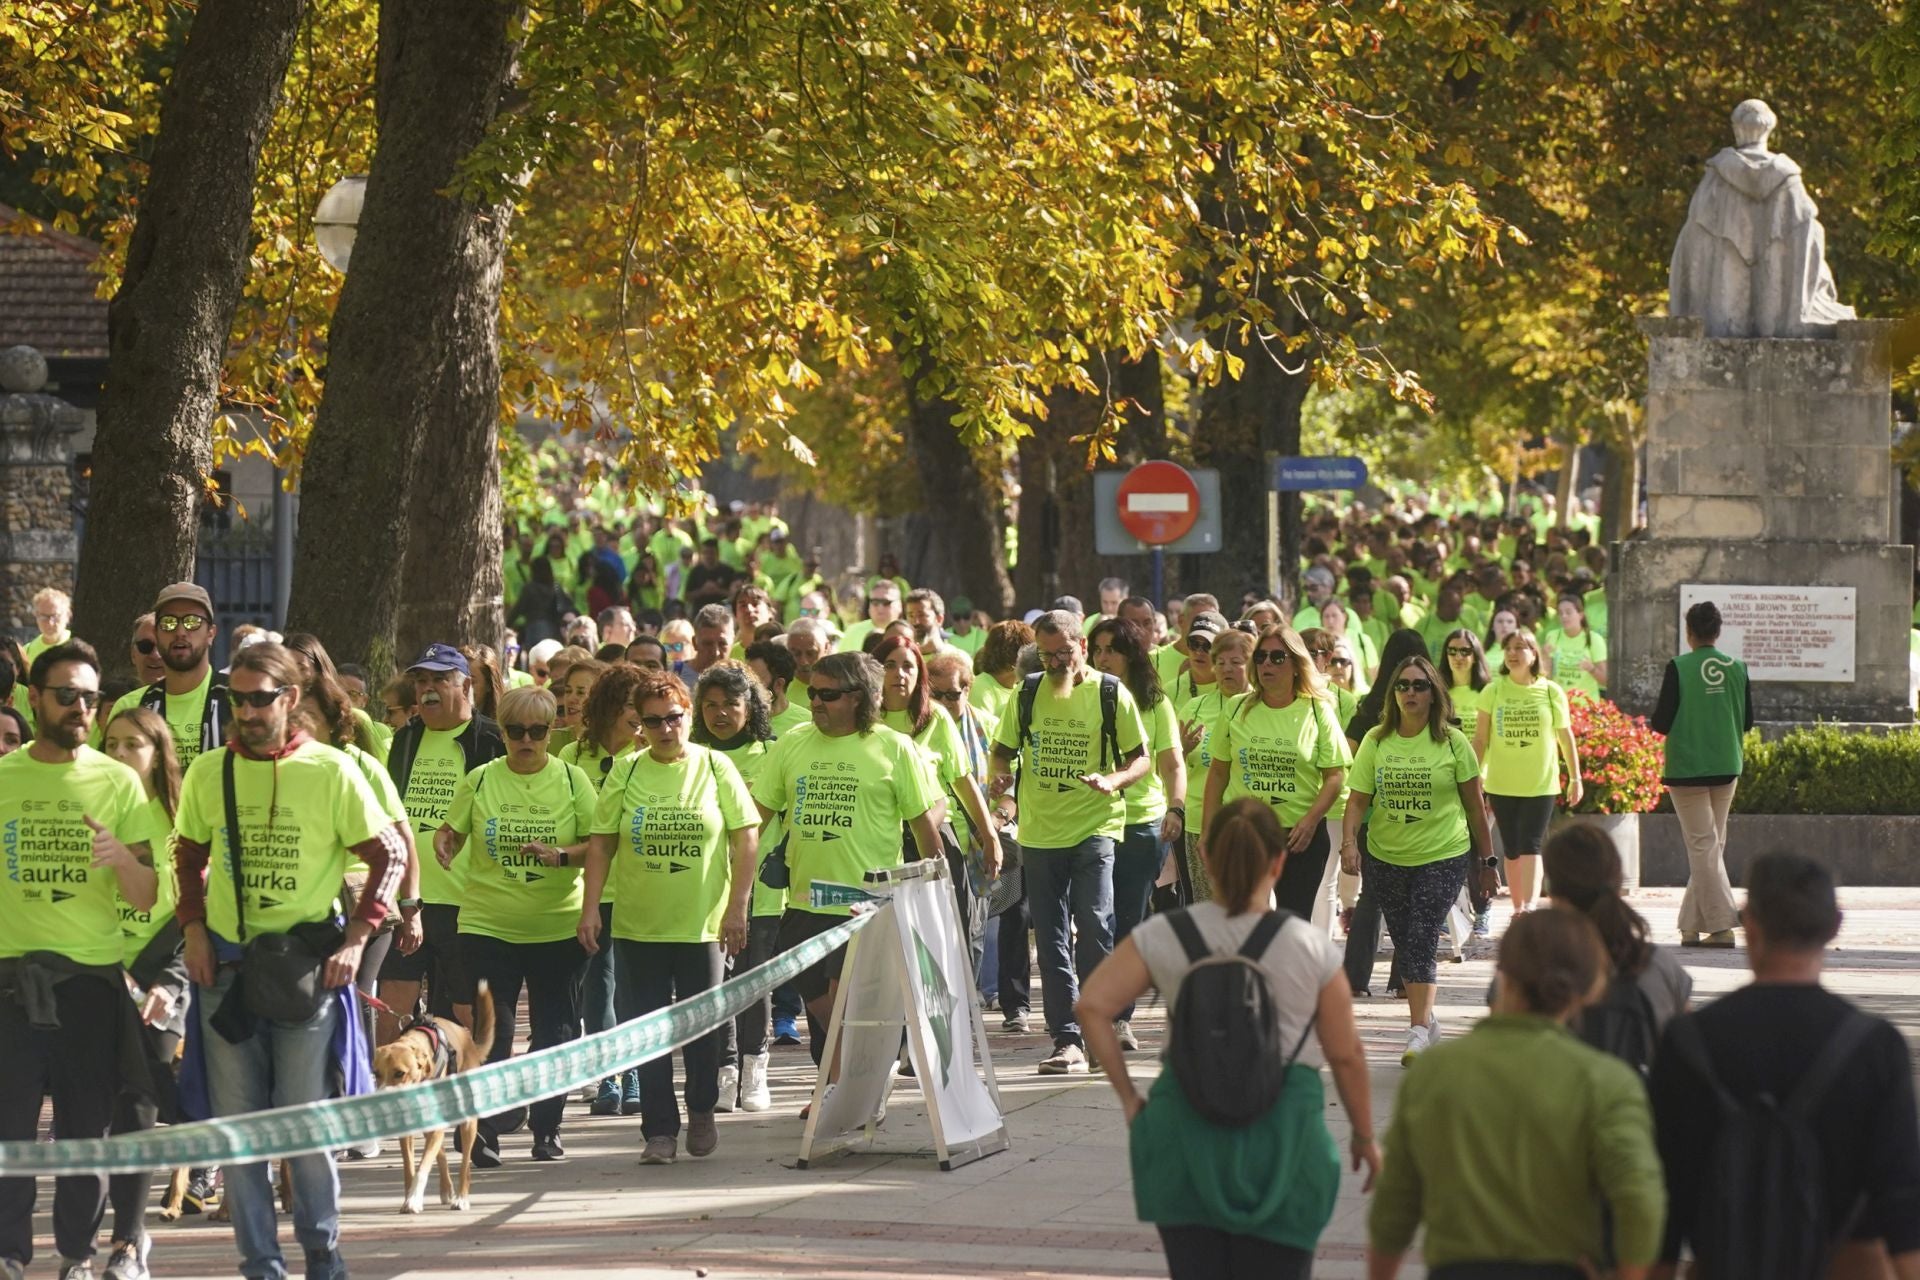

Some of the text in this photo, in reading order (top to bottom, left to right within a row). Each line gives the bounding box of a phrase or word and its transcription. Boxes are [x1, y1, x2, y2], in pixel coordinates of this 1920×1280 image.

[1722, 603, 1818, 612] JAMES BROWN SCOTT
[1505, 728, 1539, 738] aurka
[1042, 736, 1090, 748] el cáncer
[1042, 746, 1088, 758] martxan
[1041, 756, 1087, 766] minbiziaren
[1261, 754, 1296, 764] cáncer
[1250, 762, 1295, 772] martxan
[410, 776, 456, 787] el cáncer
[1384, 772, 1432, 780] el cáncer
[808, 781, 858, 792] el cáncer
[1252, 780, 1296, 792] aurka
[1384, 780, 1432, 789] martxan
[408, 786, 454, 798] martxan
[806, 792, 856, 802] martxan
[794, 776, 807, 826] ARABA
[805, 802, 855, 812] minbiziaren
[1388, 797, 1432, 810] aurka
[647, 812, 703, 820] el cáncer
[803, 811, 852, 828] aurka
[21, 825, 90, 838] el cáncer
[500, 824, 556, 834] el cáncer
[632, 806, 646, 856] ARABA
[645, 820, 704, 832] martxan
[251, 831, 301, 845] cáncer
[486, 817, 498, 862] RABA
[644, 832, 703, 840] minbiziaren
[4, 819, 20, 883] ARABA
[21, 838, 90, 852] martxan
[646, 841, 702, 858] aurka
[21, 852, 90, 864] minbiziaren
[502, 854, 544, 867] aurk
[22, 864, 88, 884] aurka
[242, 870, 296, 890] urka
